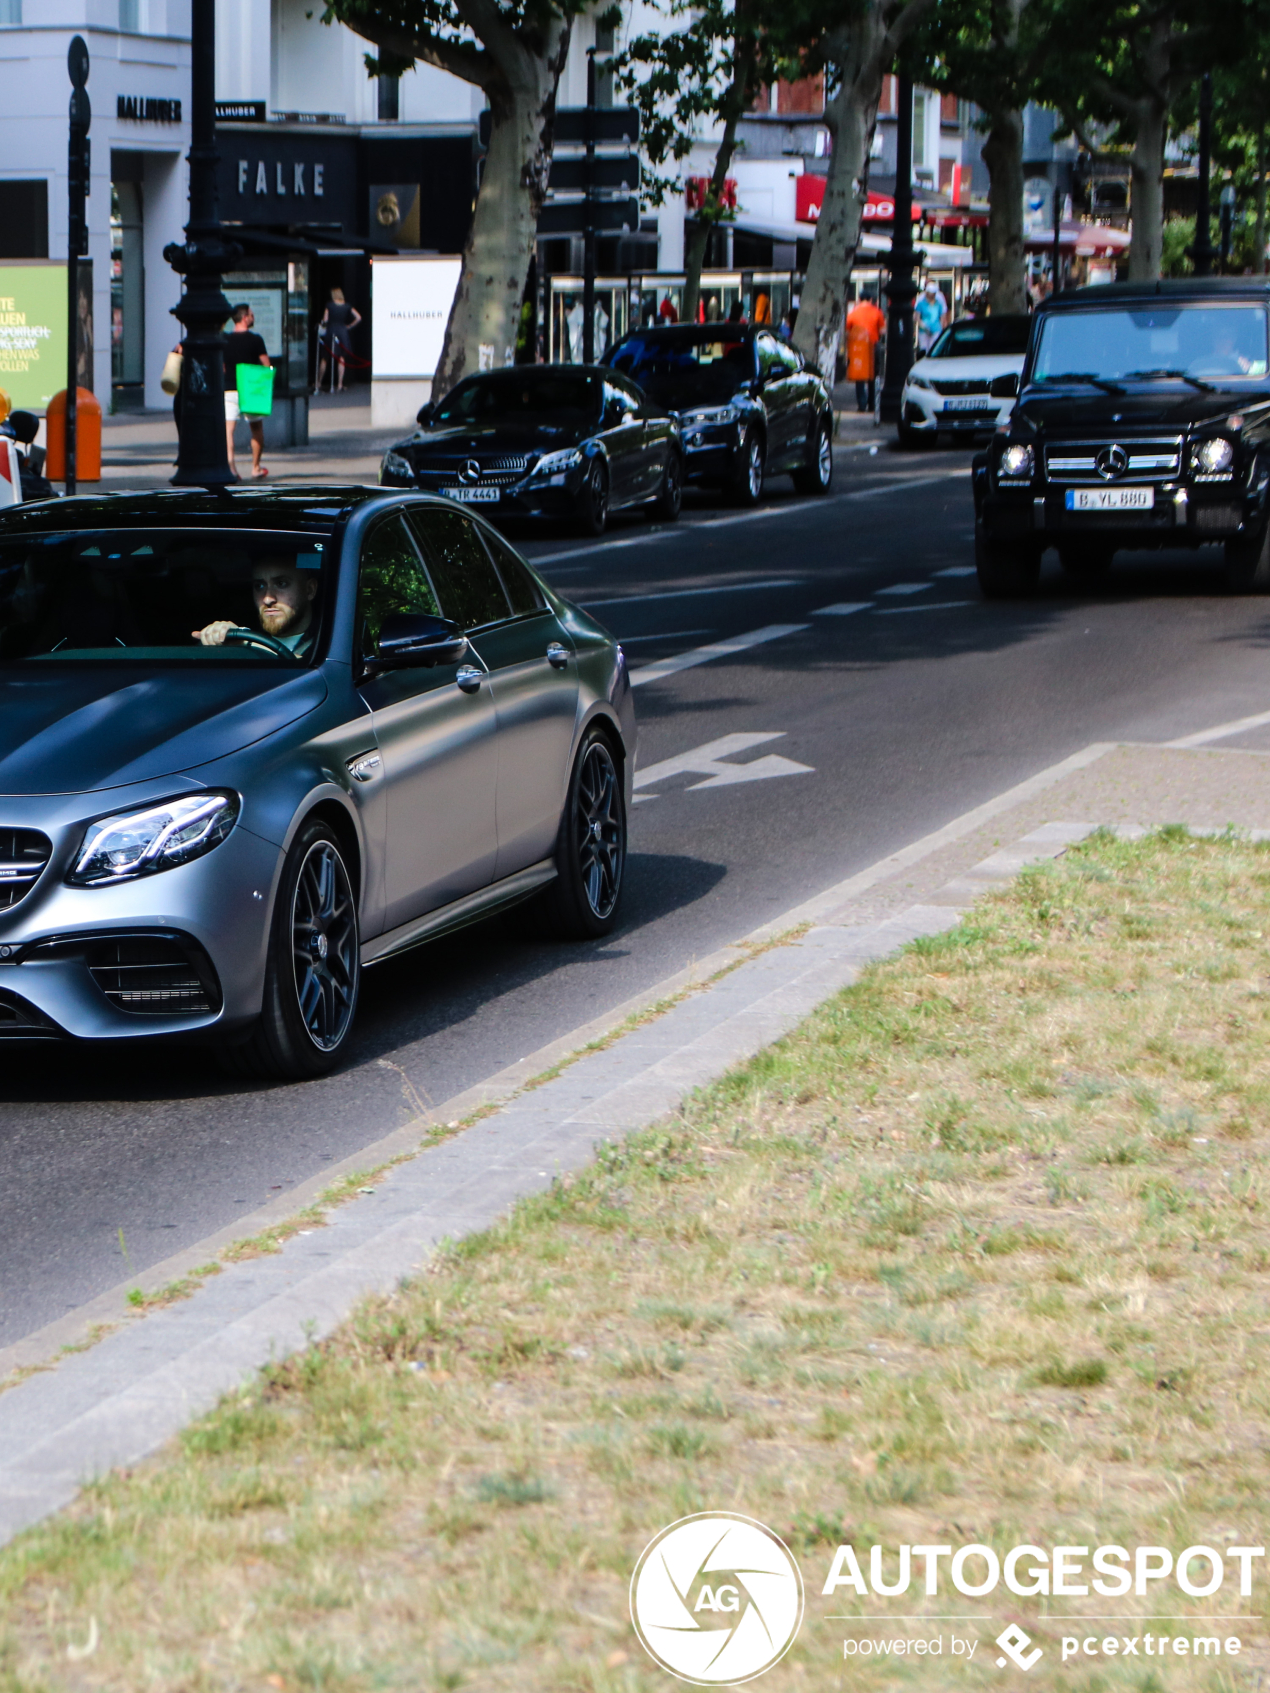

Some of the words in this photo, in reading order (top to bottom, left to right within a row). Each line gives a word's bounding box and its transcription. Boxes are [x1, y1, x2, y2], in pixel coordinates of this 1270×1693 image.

[117, 94, 182, 123] HALLHUBER
[215, 106, 256, 117] LLHUBER
[238, 160, 325, 196] FALKE
[390, 310, 443, 319] HALLHUBER
[17, 349, 40, 361] WAS
[458, 488, 470, 500] TR
[473, 487, 497, 500] 4441
